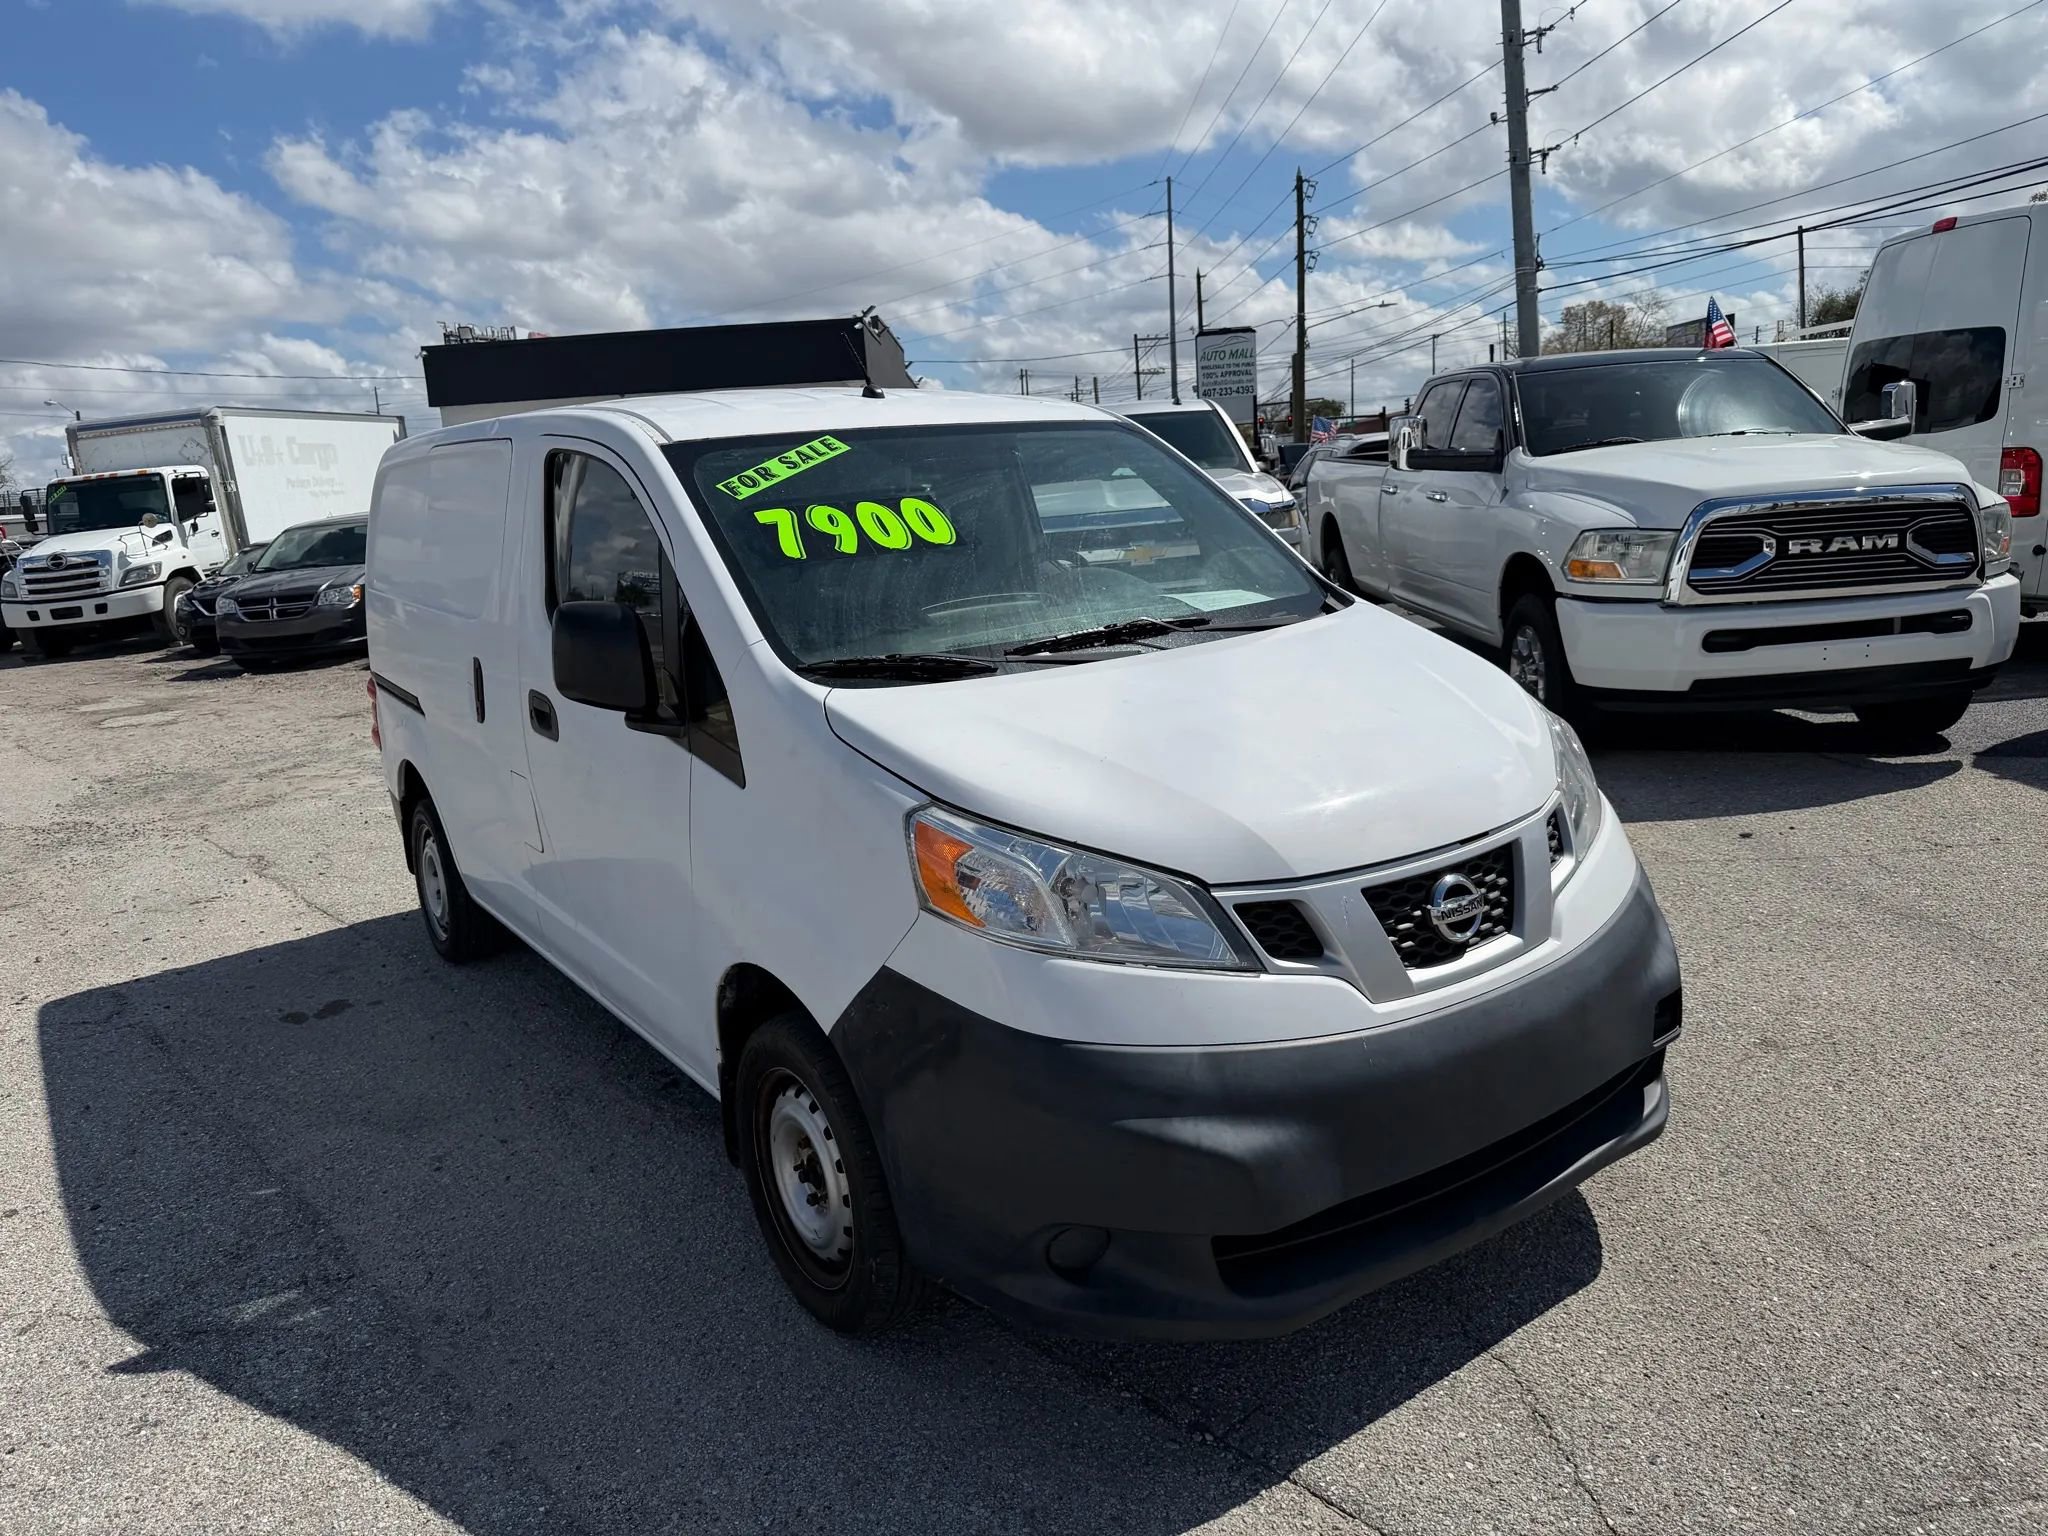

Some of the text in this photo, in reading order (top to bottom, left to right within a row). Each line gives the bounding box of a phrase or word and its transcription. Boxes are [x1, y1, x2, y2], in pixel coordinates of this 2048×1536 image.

[1200, 348, 1255, 361] AUTO MALL
[1220, 369, 1253, 378] APPROVAL
[1202, 385, 1255, 397] 407-233-4393
[723, 438, 842, 497] FOR SALE
[754, 497, 957, 560] 7900
[1788, 534, 1899, 555] RAM
[1441, 898, 1483, 921] NISSAN
